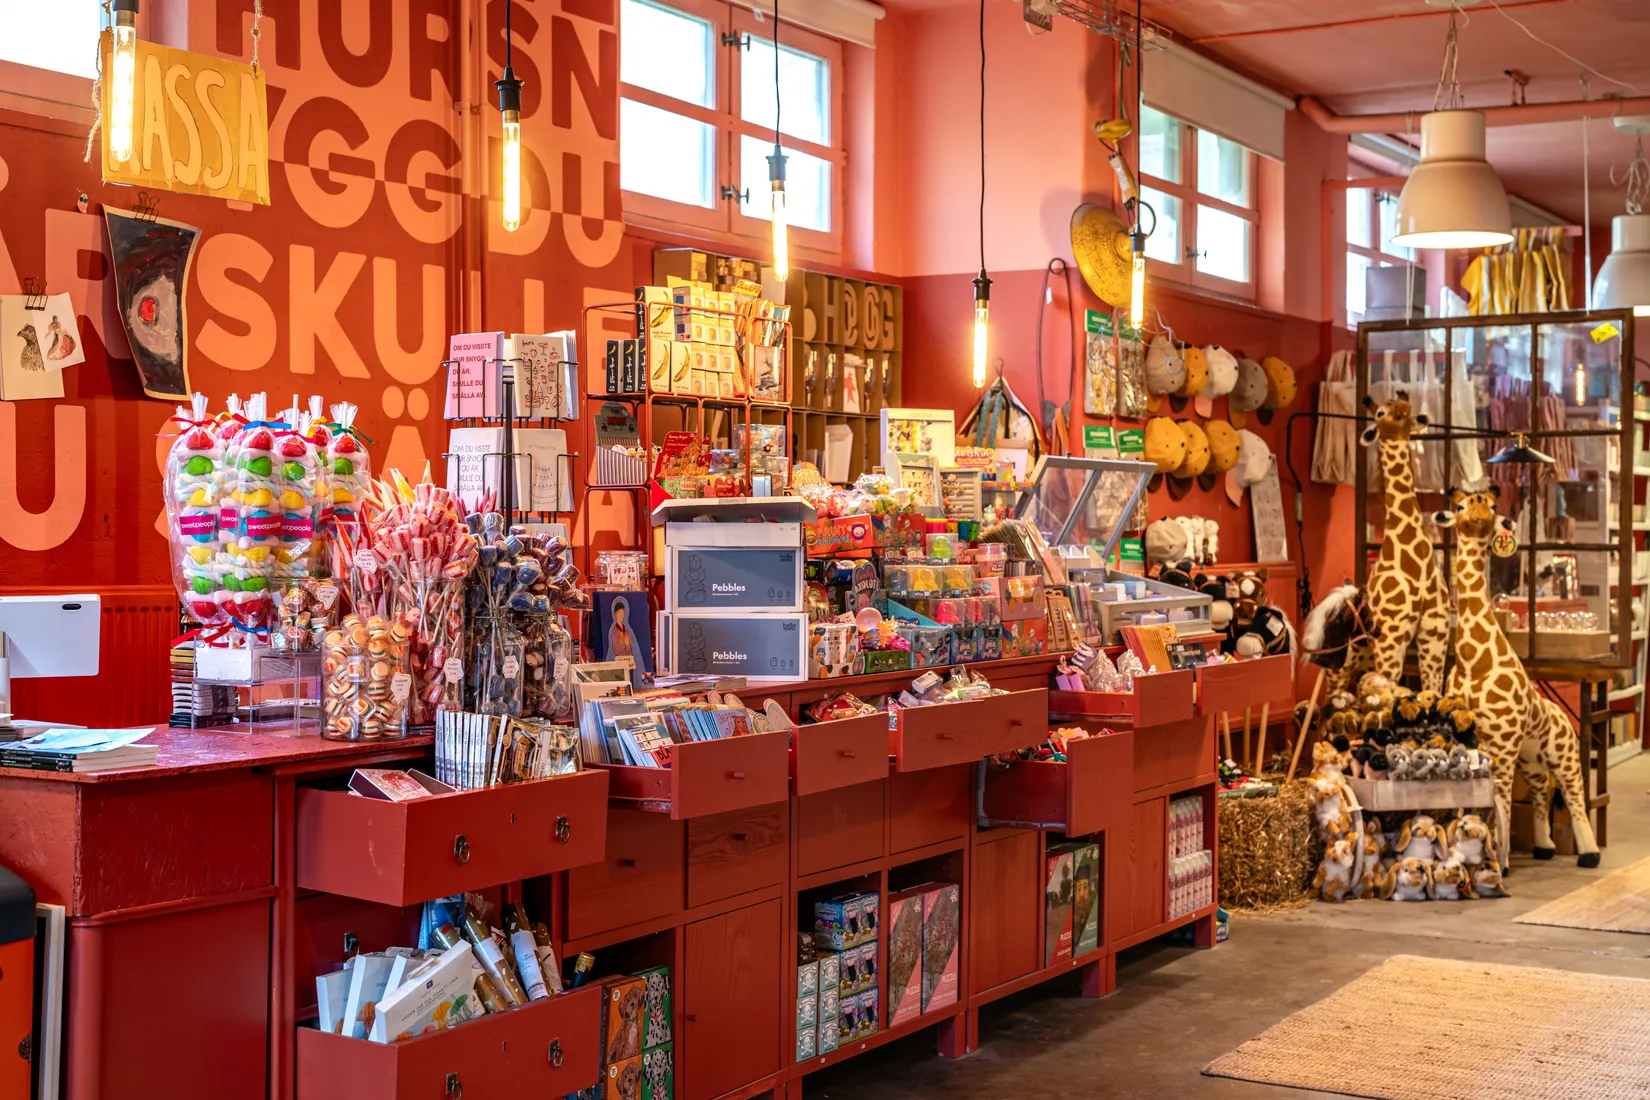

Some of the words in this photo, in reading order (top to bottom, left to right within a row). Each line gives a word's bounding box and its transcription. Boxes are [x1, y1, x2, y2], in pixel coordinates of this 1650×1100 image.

[817, 523, 847, 537] FRUIT
[613, 566, 635, 574] FRUTS
[712, 582, 746, 592] Pebbles
[712, 651, 748, 660] Pebbles
